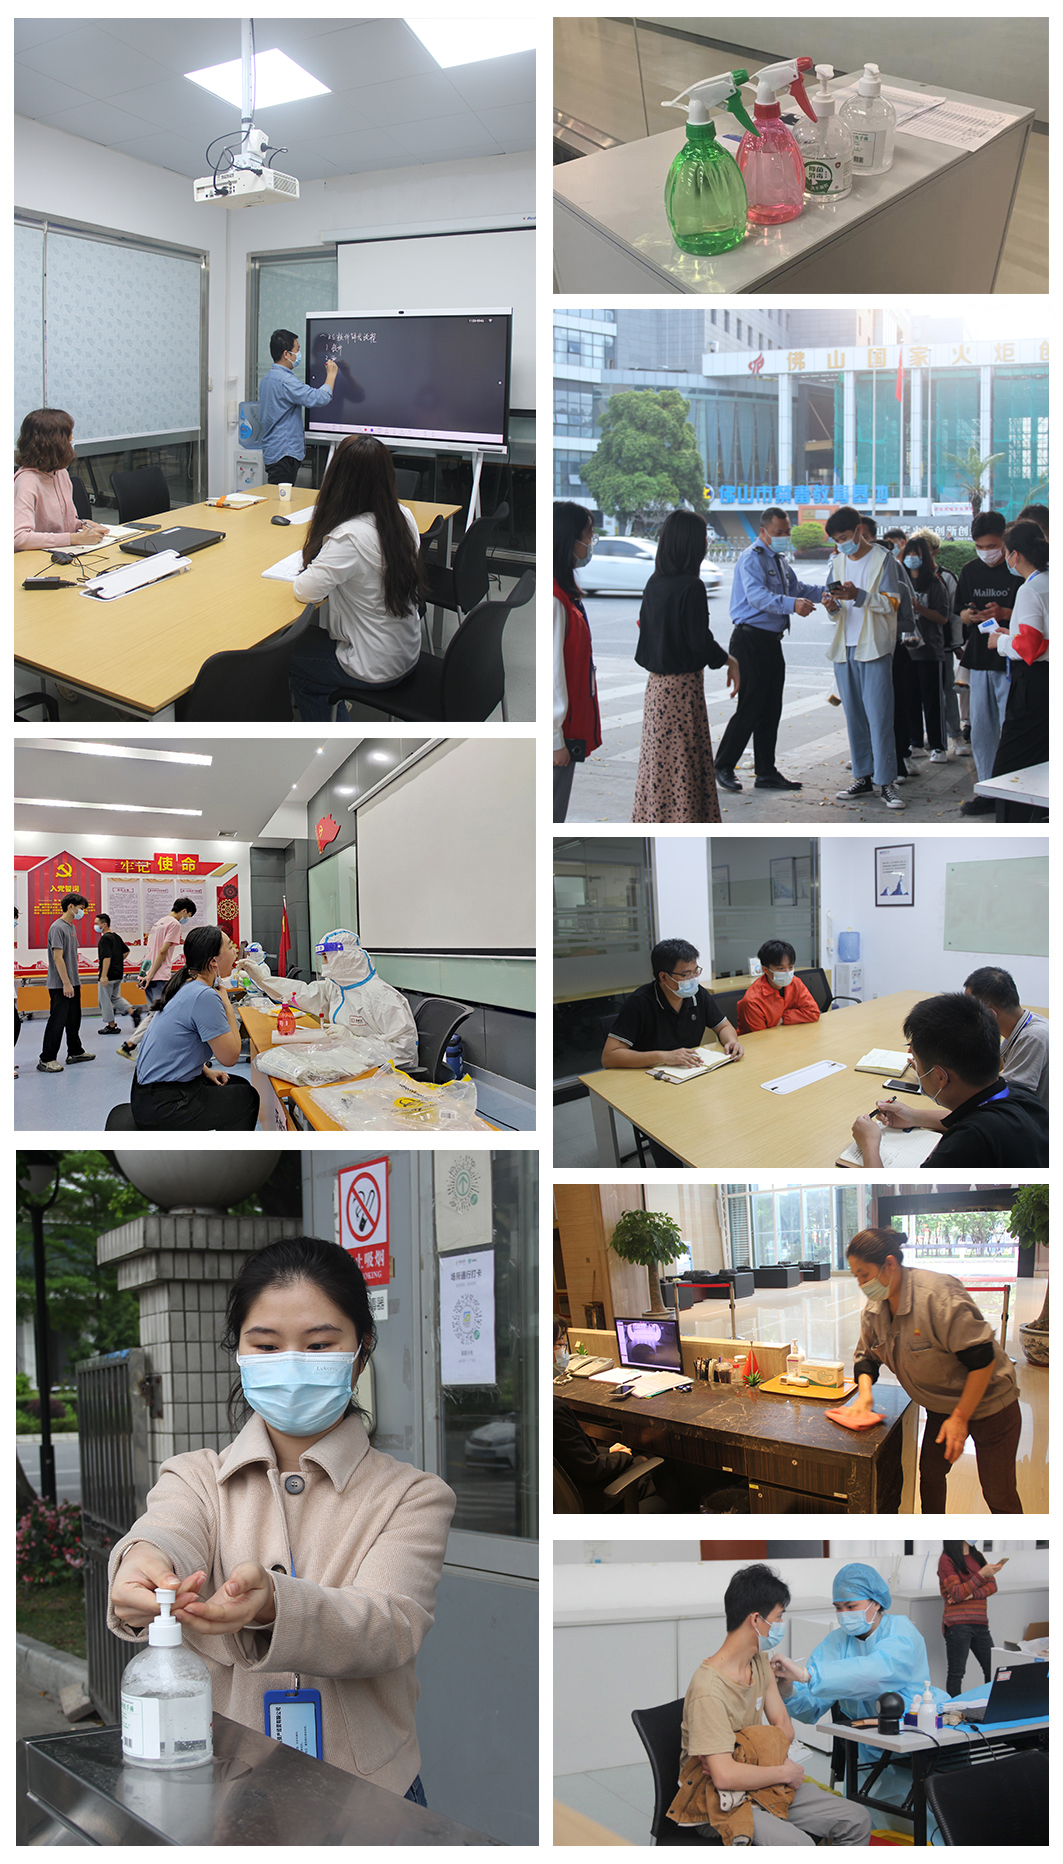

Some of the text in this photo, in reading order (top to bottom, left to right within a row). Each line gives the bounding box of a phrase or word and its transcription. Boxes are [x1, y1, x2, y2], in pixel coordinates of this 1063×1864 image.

[718, 484, 889, 504] 佛山市禁毒教育基地
[120, 856, 197, 873] 牢记使命
[49, 885, 80, 893] 入党誓词
